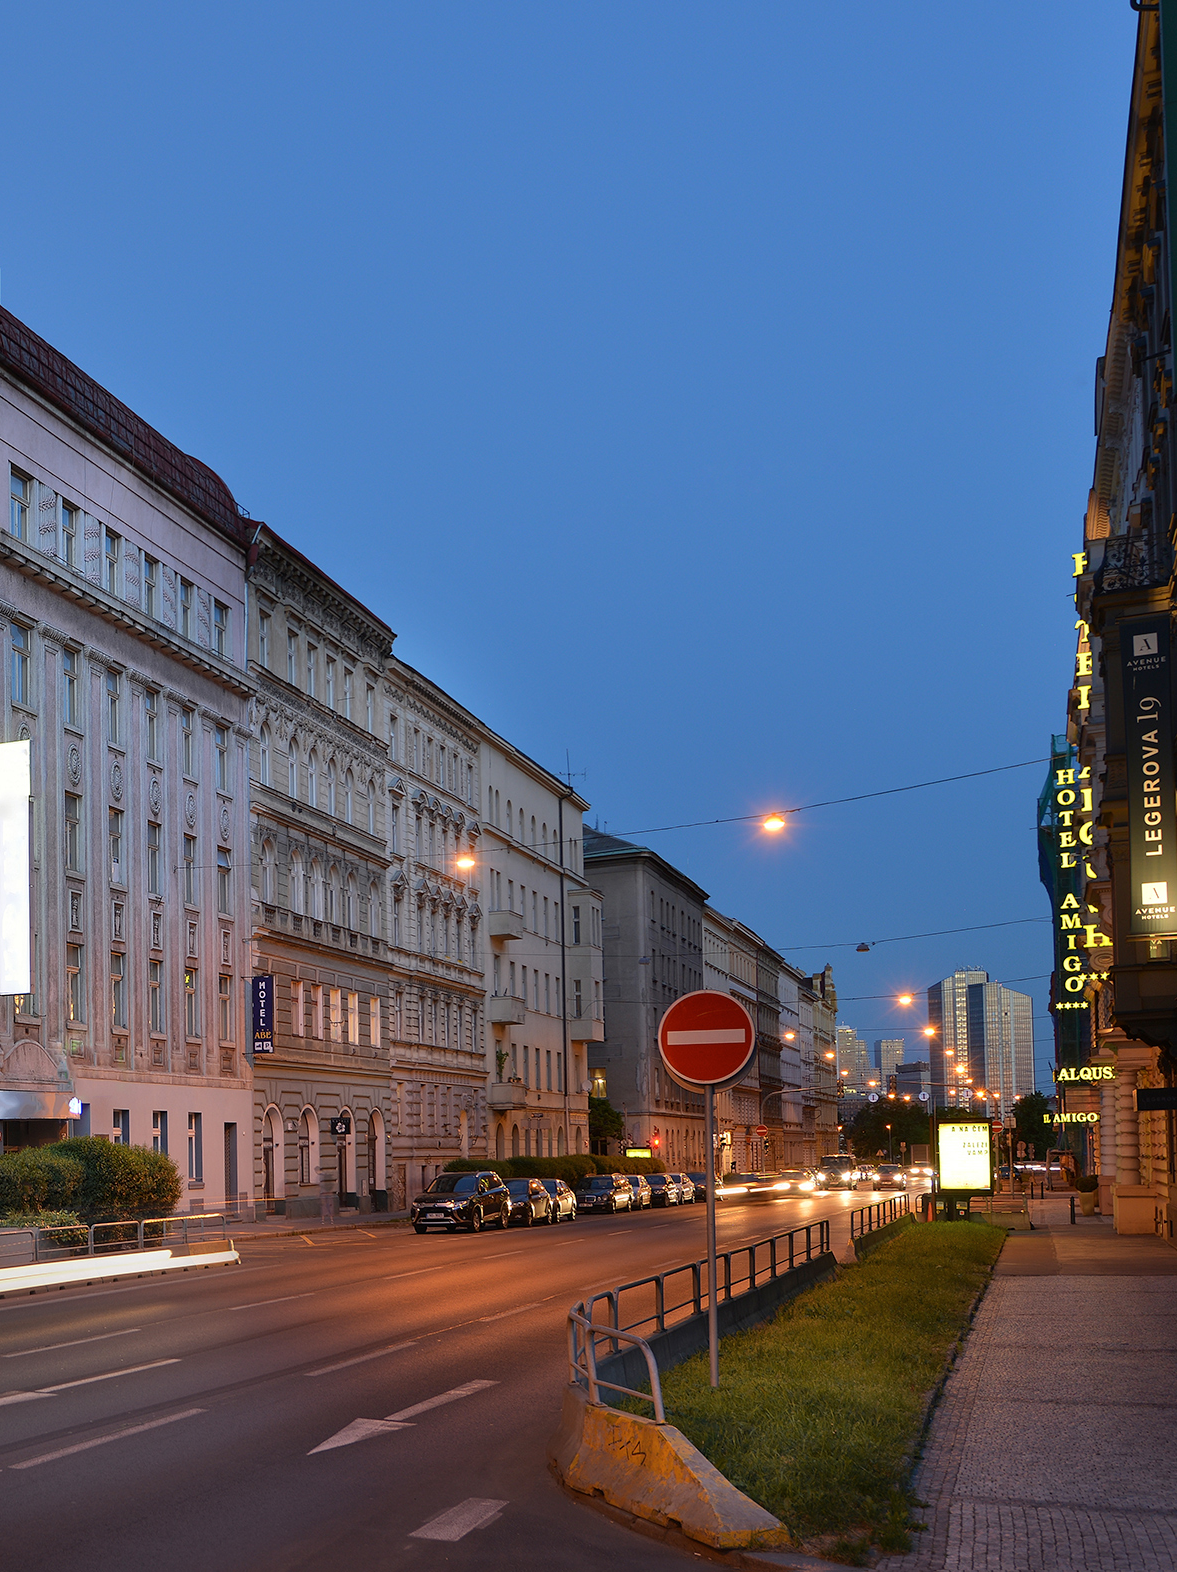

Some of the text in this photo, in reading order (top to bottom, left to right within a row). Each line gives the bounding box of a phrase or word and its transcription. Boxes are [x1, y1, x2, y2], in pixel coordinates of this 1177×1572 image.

[1126, 656, 1167, 667] AVENUE
[1136, 696, 1164, 857] LEGEROVA 19
[1056, 768, 1084, 992] HOTEL AMIGO
[1135, 905, 1176, 915] AVENUE
[1057, 1066, 1116, 1081] ALQUS
[1053, 1112, 1098, 1123] AMIGO
